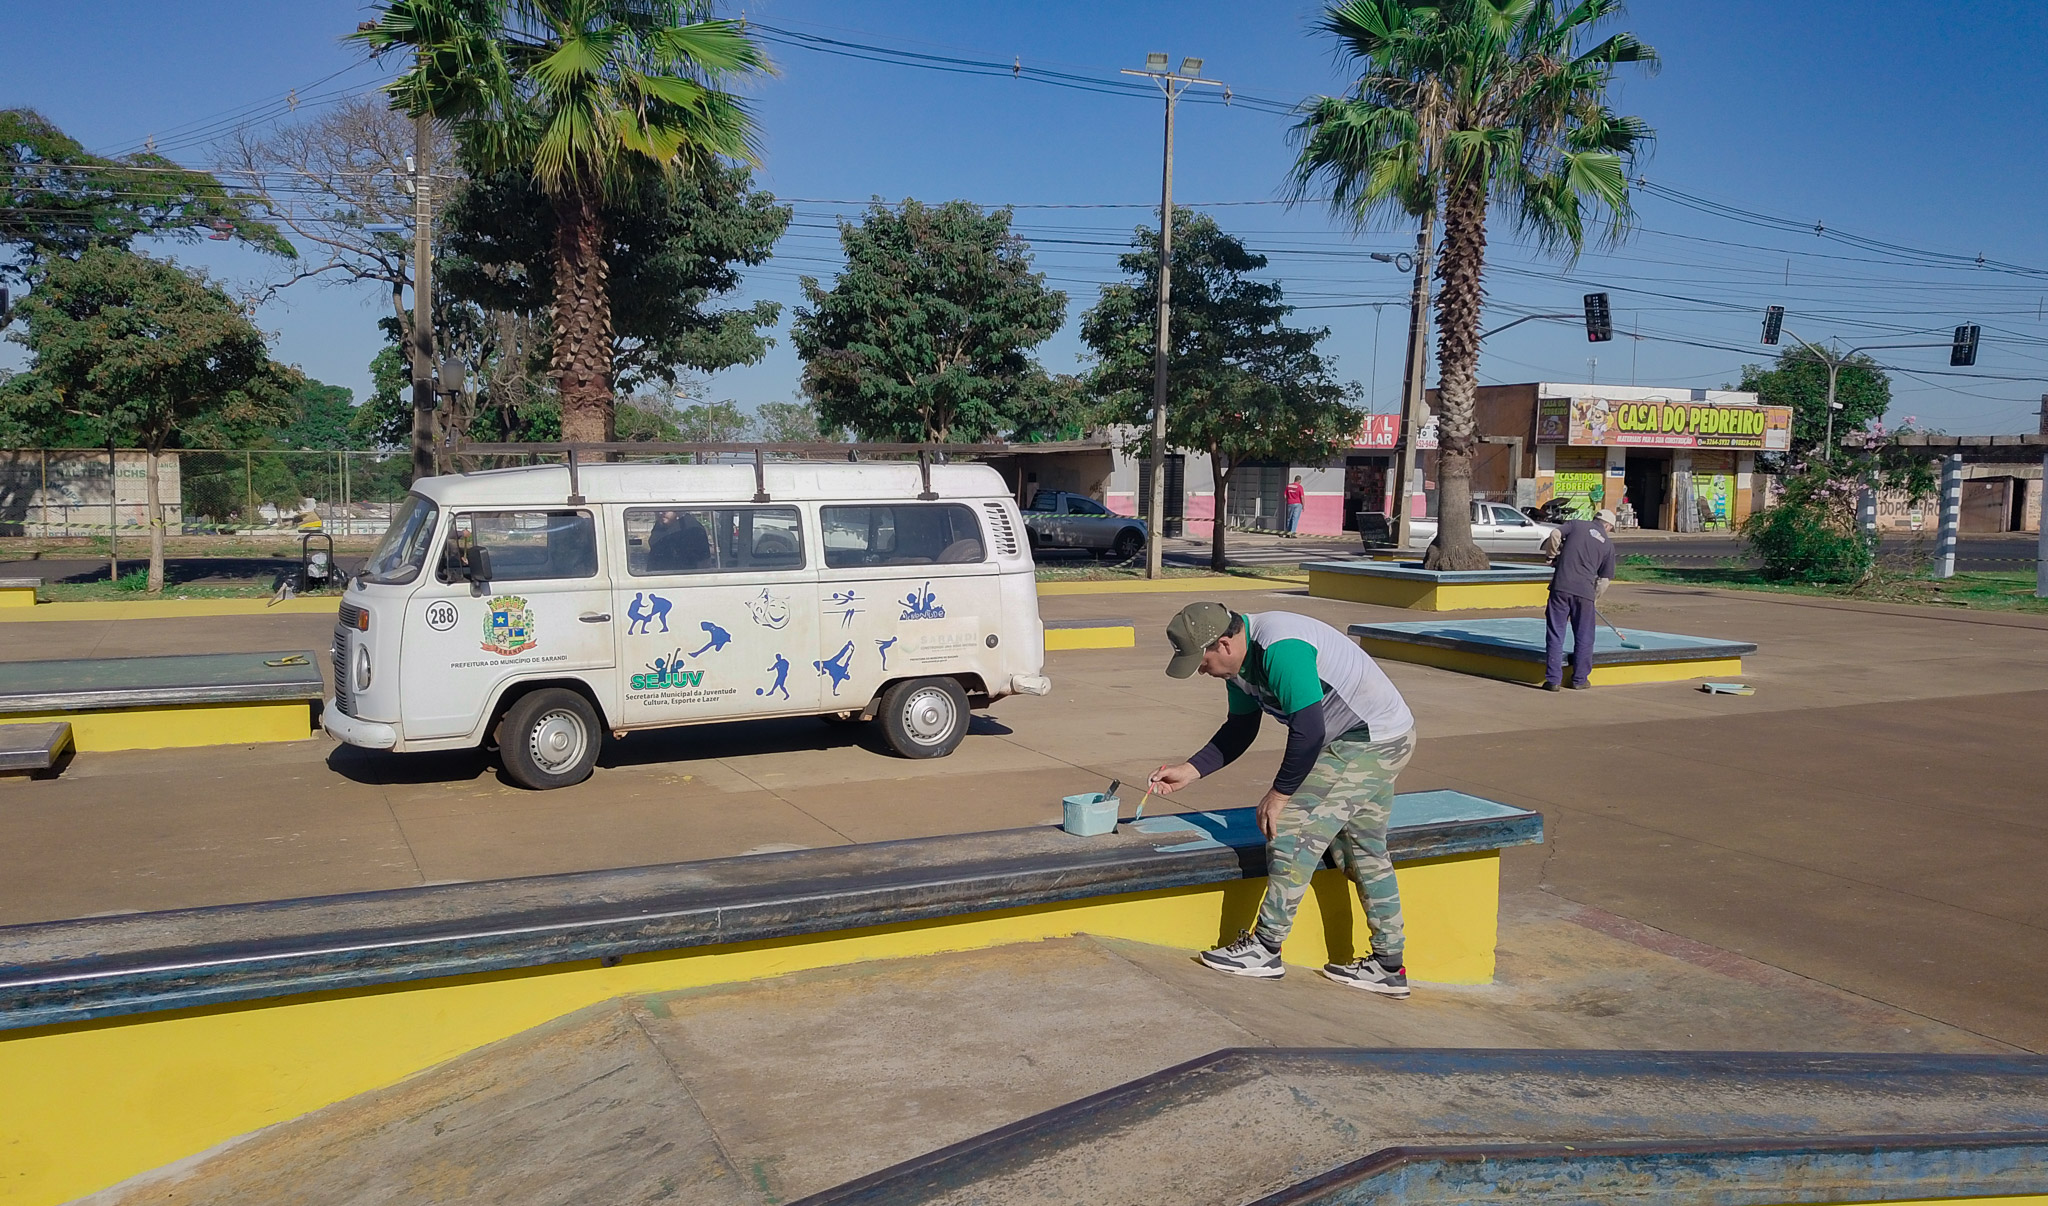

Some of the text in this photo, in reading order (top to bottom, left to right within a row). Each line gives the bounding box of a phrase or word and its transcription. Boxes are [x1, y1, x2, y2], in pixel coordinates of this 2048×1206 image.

[1618, 404, 1765, 435] CASA DO PEDREIRO
[108, 469, 146, 478] UCHS
[1560, 473, 1578, 481] CASA
[430, 608, 454, 624] 288
[450, 661, 489, 669] PREFEITURA
[630, 670, 705, 690] SEJUV
[625, 693, 660, 701] Secretaria
[660, 690, 693, 699] Municipal
[703, 688, 737, 696] Juventude
[671, 697, 696, 705] Esporte
